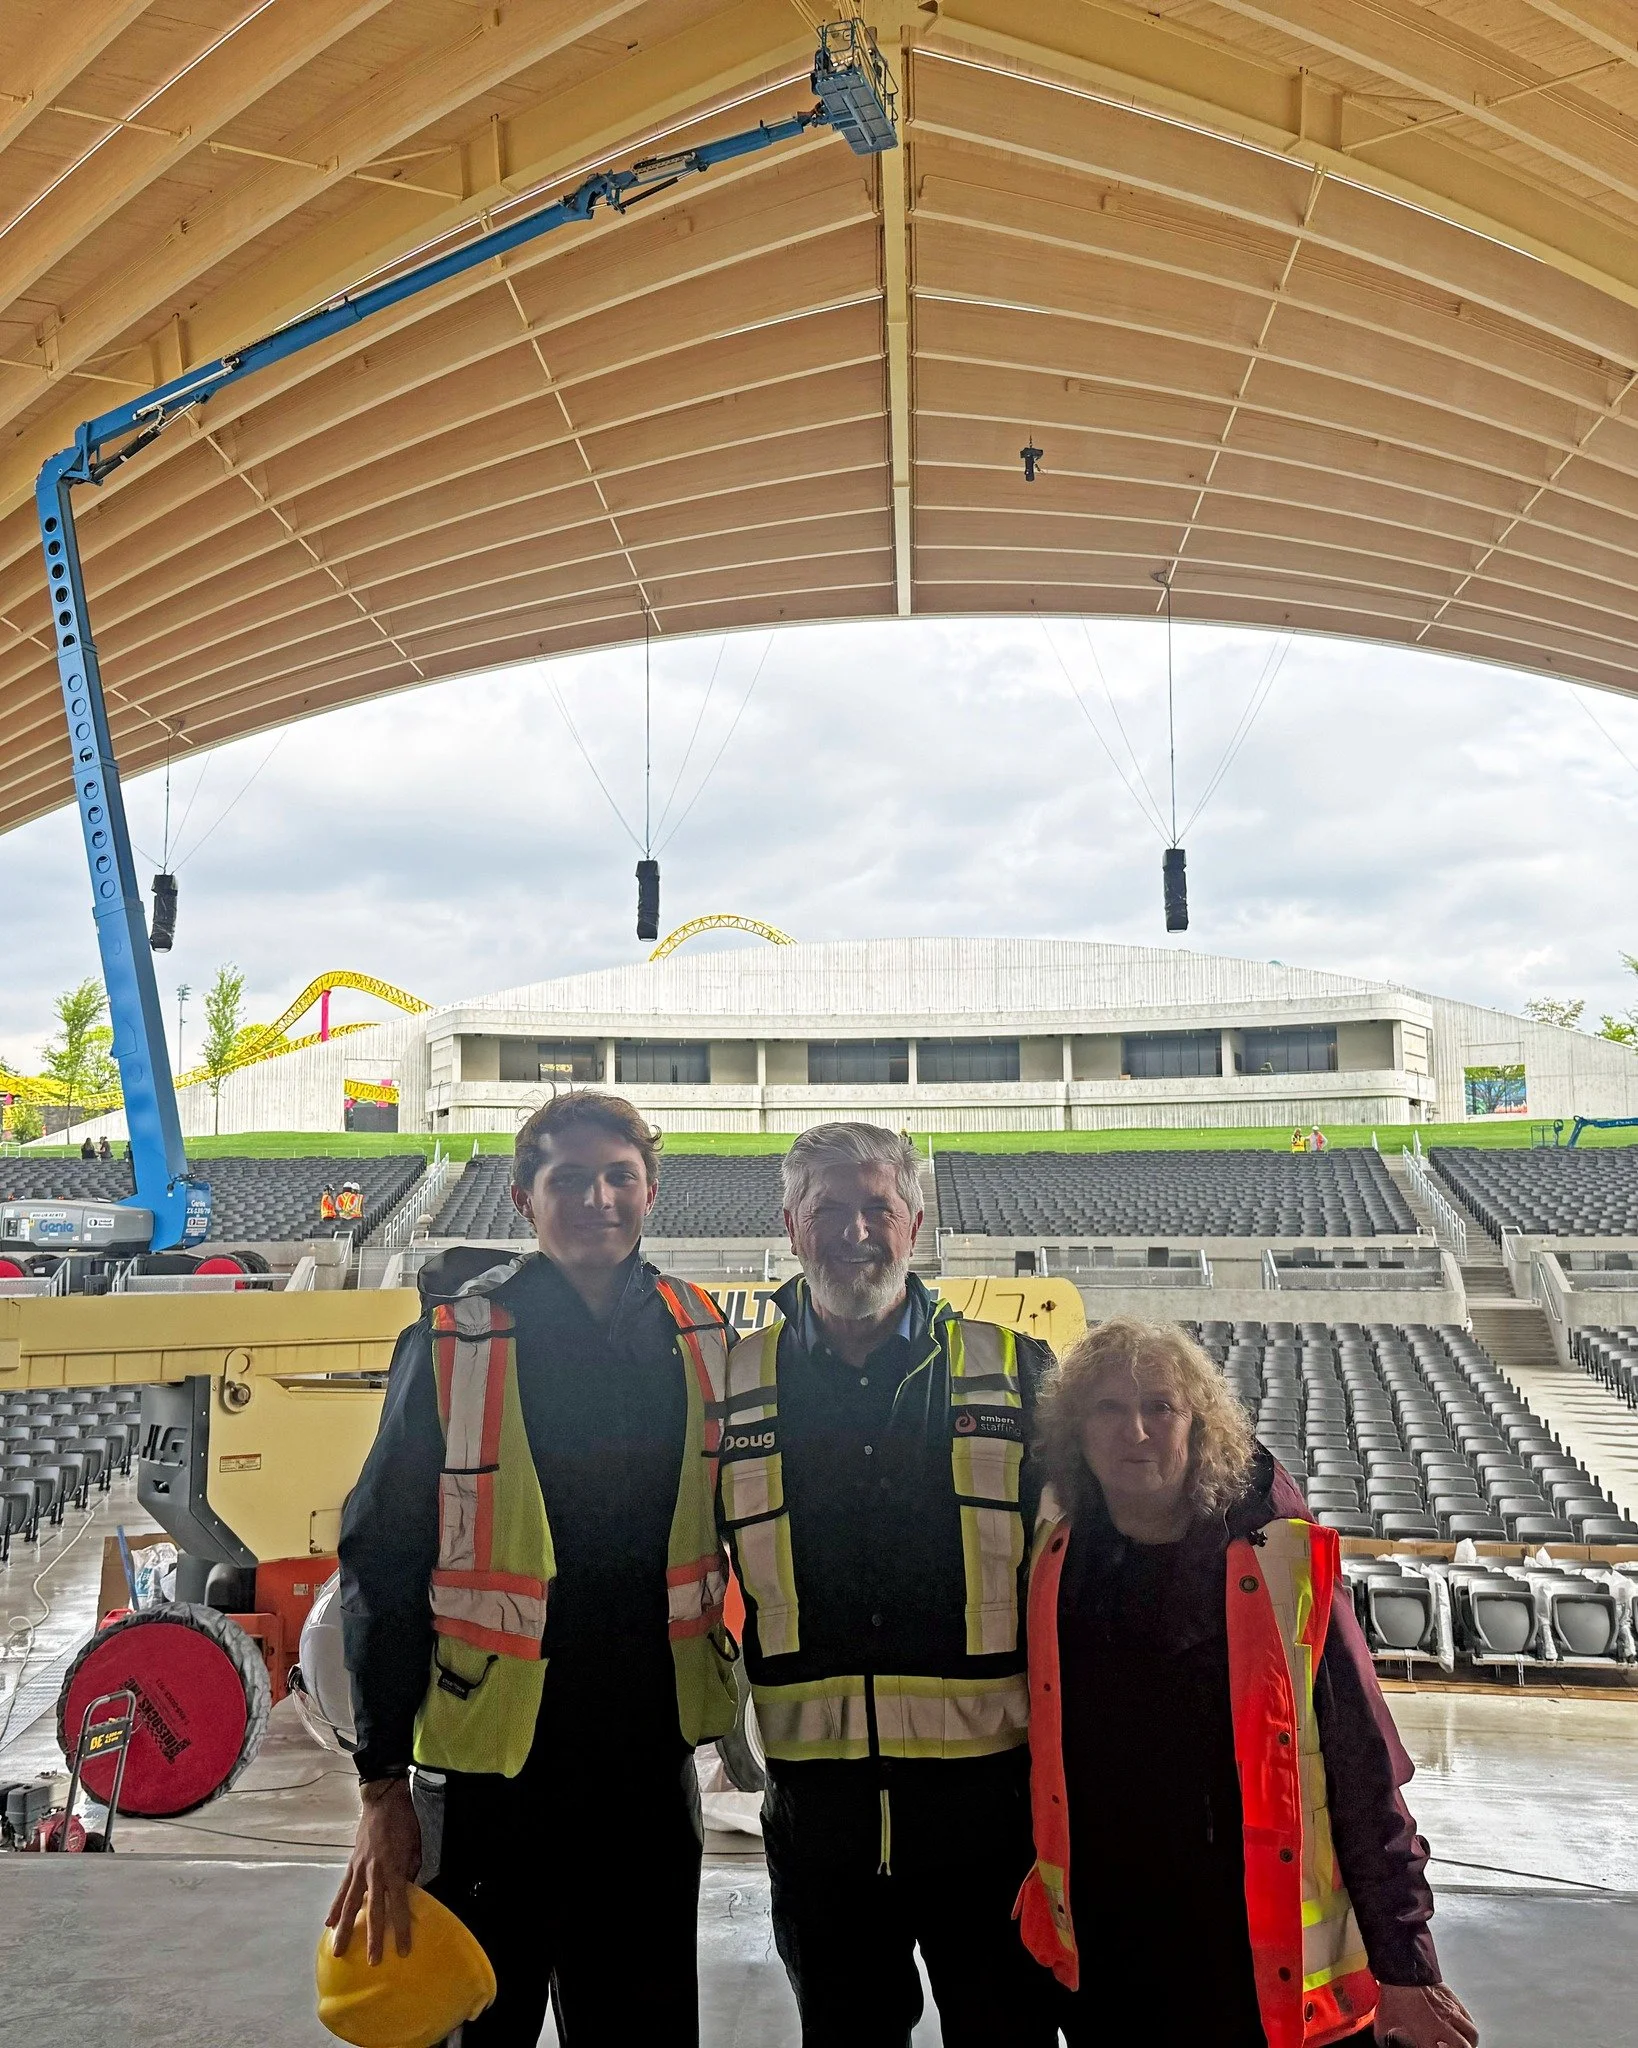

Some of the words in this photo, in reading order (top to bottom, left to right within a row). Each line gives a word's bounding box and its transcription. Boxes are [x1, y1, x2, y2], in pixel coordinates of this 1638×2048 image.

[39, 1219, 74, 1233] Genie
[711, 1290, 786, 1329] ULT
[980, 1415, 1015, 1425] embers
[980, 1423, 1021, 1437] staffing
[141, 1424, 188, 1467] JLG
[724, 1431, 775, 1452] Doug
